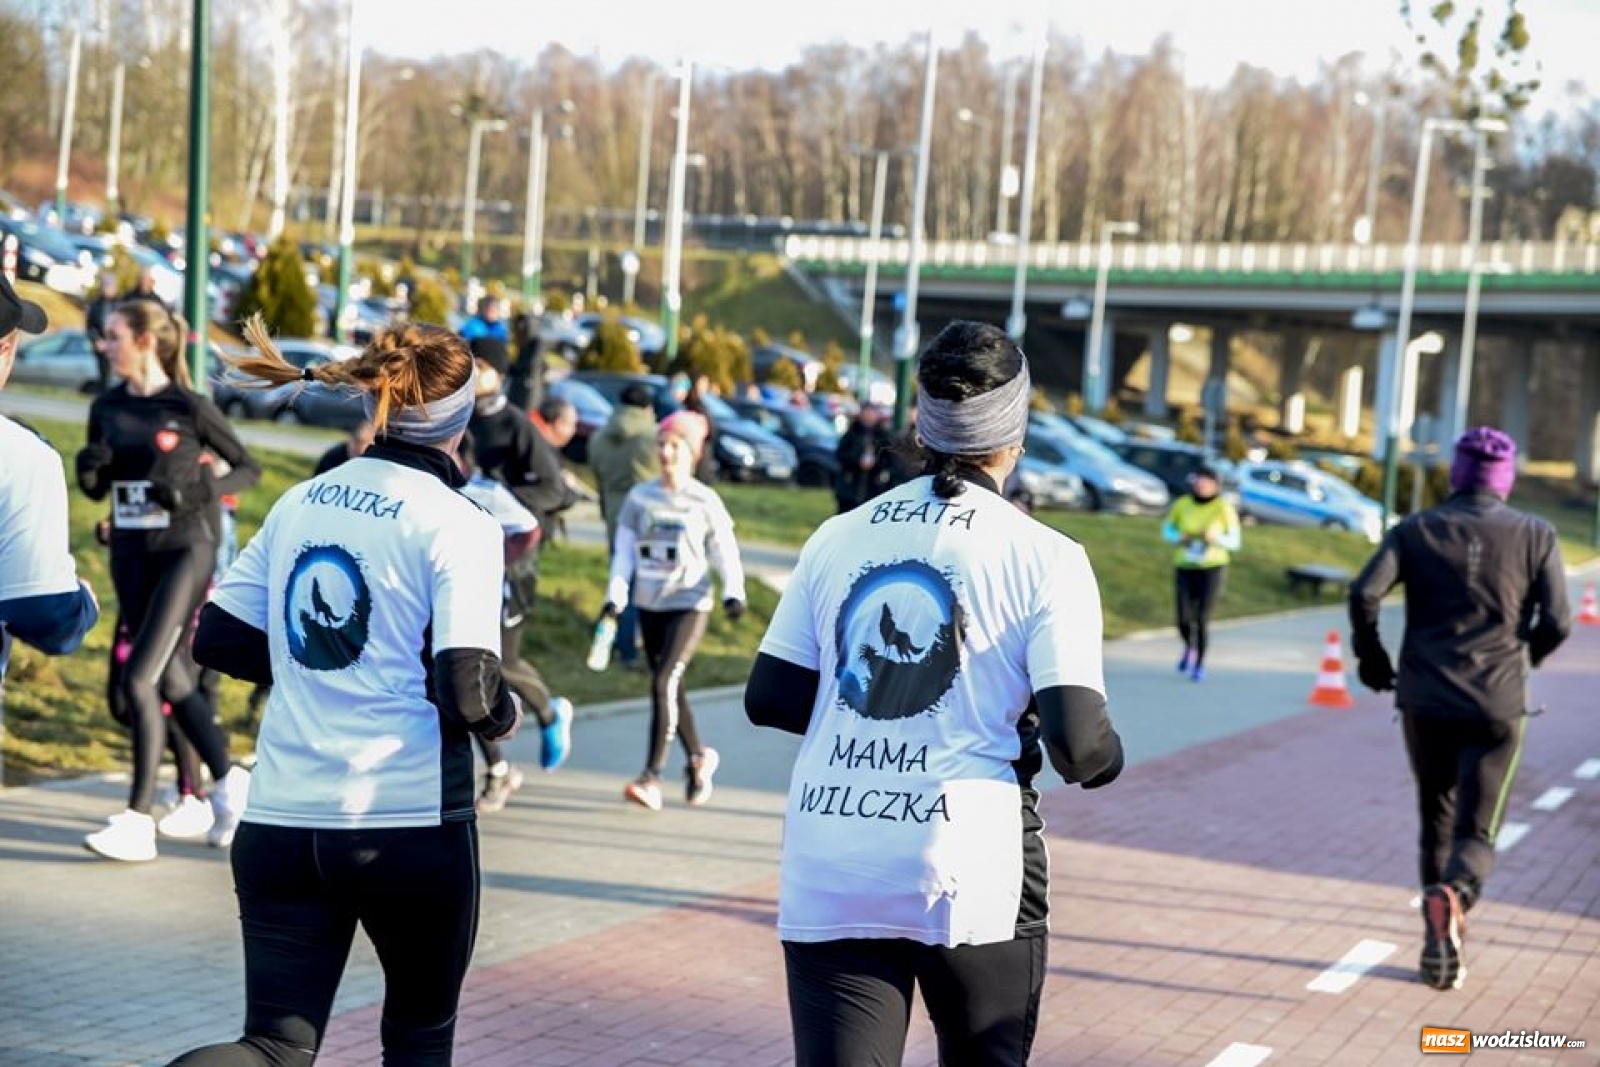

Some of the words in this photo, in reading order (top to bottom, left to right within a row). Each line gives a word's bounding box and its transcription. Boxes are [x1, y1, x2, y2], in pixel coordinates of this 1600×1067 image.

[301, 482, 405, 519] MONIKA
[870, 499, 976, 530] BEATA
[828, 734, 929, 773] MAMA
[799, 781, 951, 824] WILCZKA
